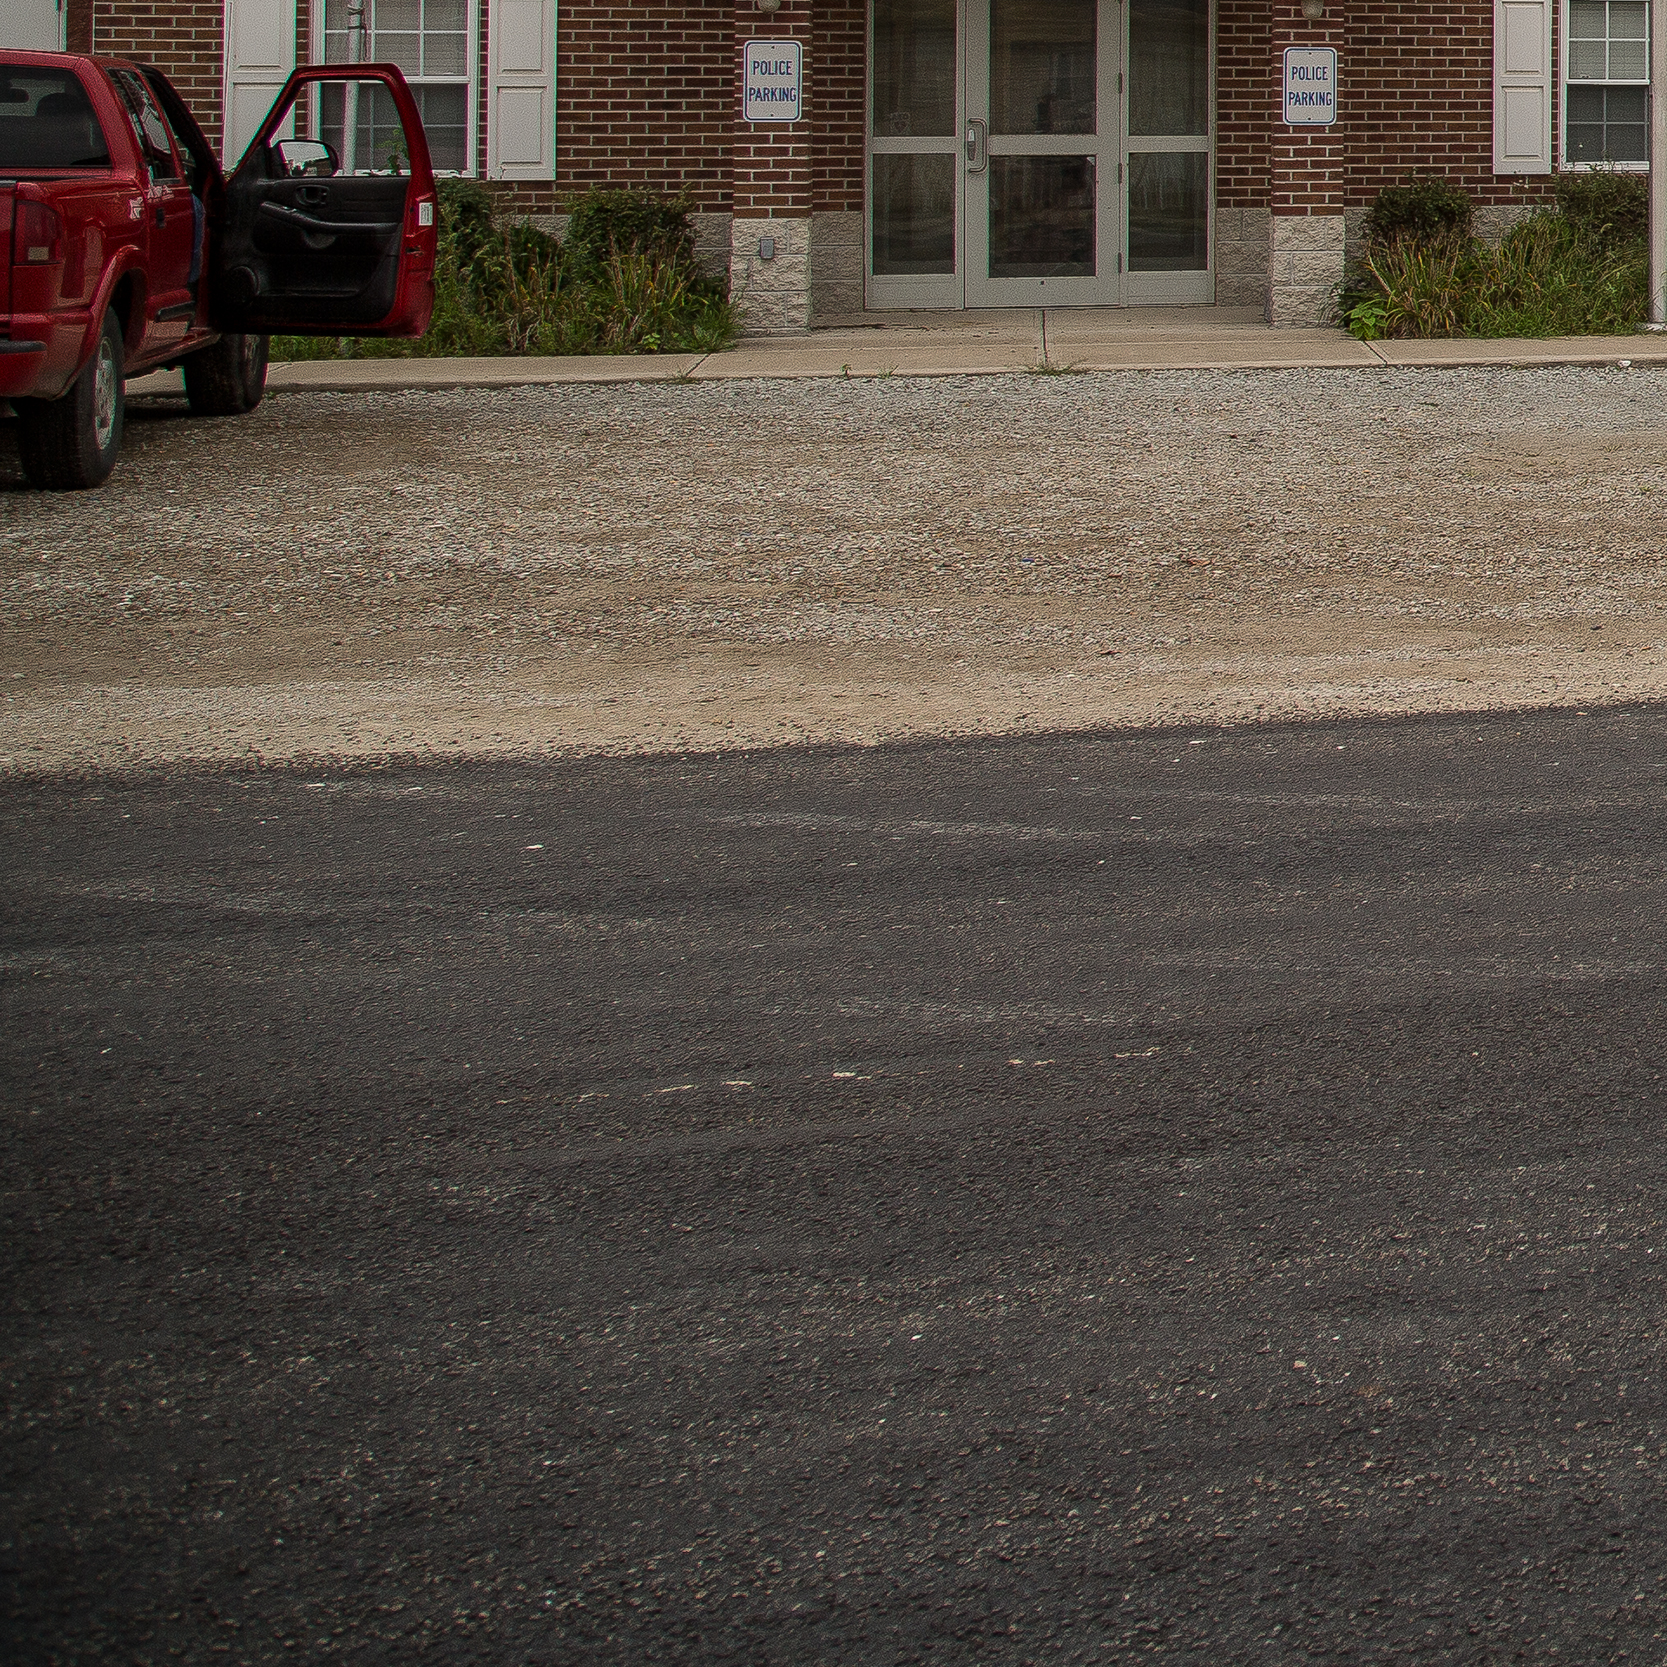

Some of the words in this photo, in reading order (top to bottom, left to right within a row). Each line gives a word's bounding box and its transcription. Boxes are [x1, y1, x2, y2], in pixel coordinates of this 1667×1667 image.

[752, 60, 793, 75] POLICE
[1291, 66, 1328, 80] POLICE
[748, 87, 796, 102] PARKING
[1288, 92, 1332, 106] PARKING
